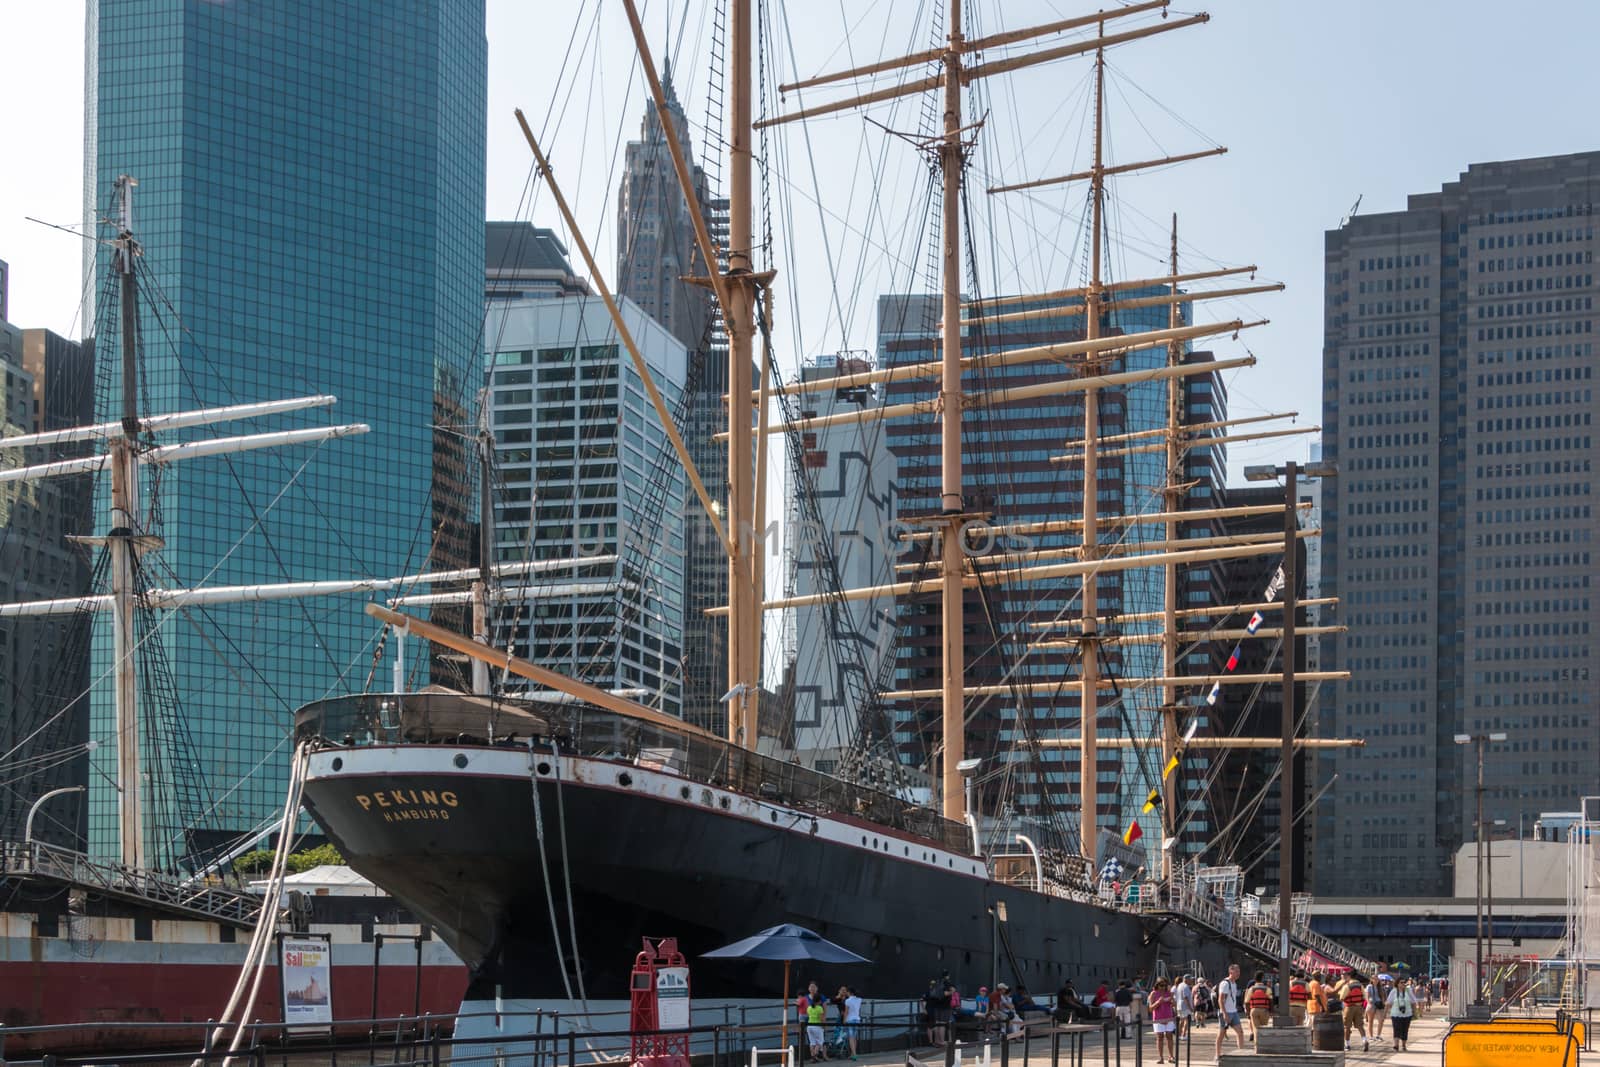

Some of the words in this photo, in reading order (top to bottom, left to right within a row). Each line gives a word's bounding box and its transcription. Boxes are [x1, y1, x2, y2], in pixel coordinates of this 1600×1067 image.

[355, 789, 459, 811] PEKING
[383, 809, 450, 822] HAMBURG
[285, 952, 303, 967] Sail
